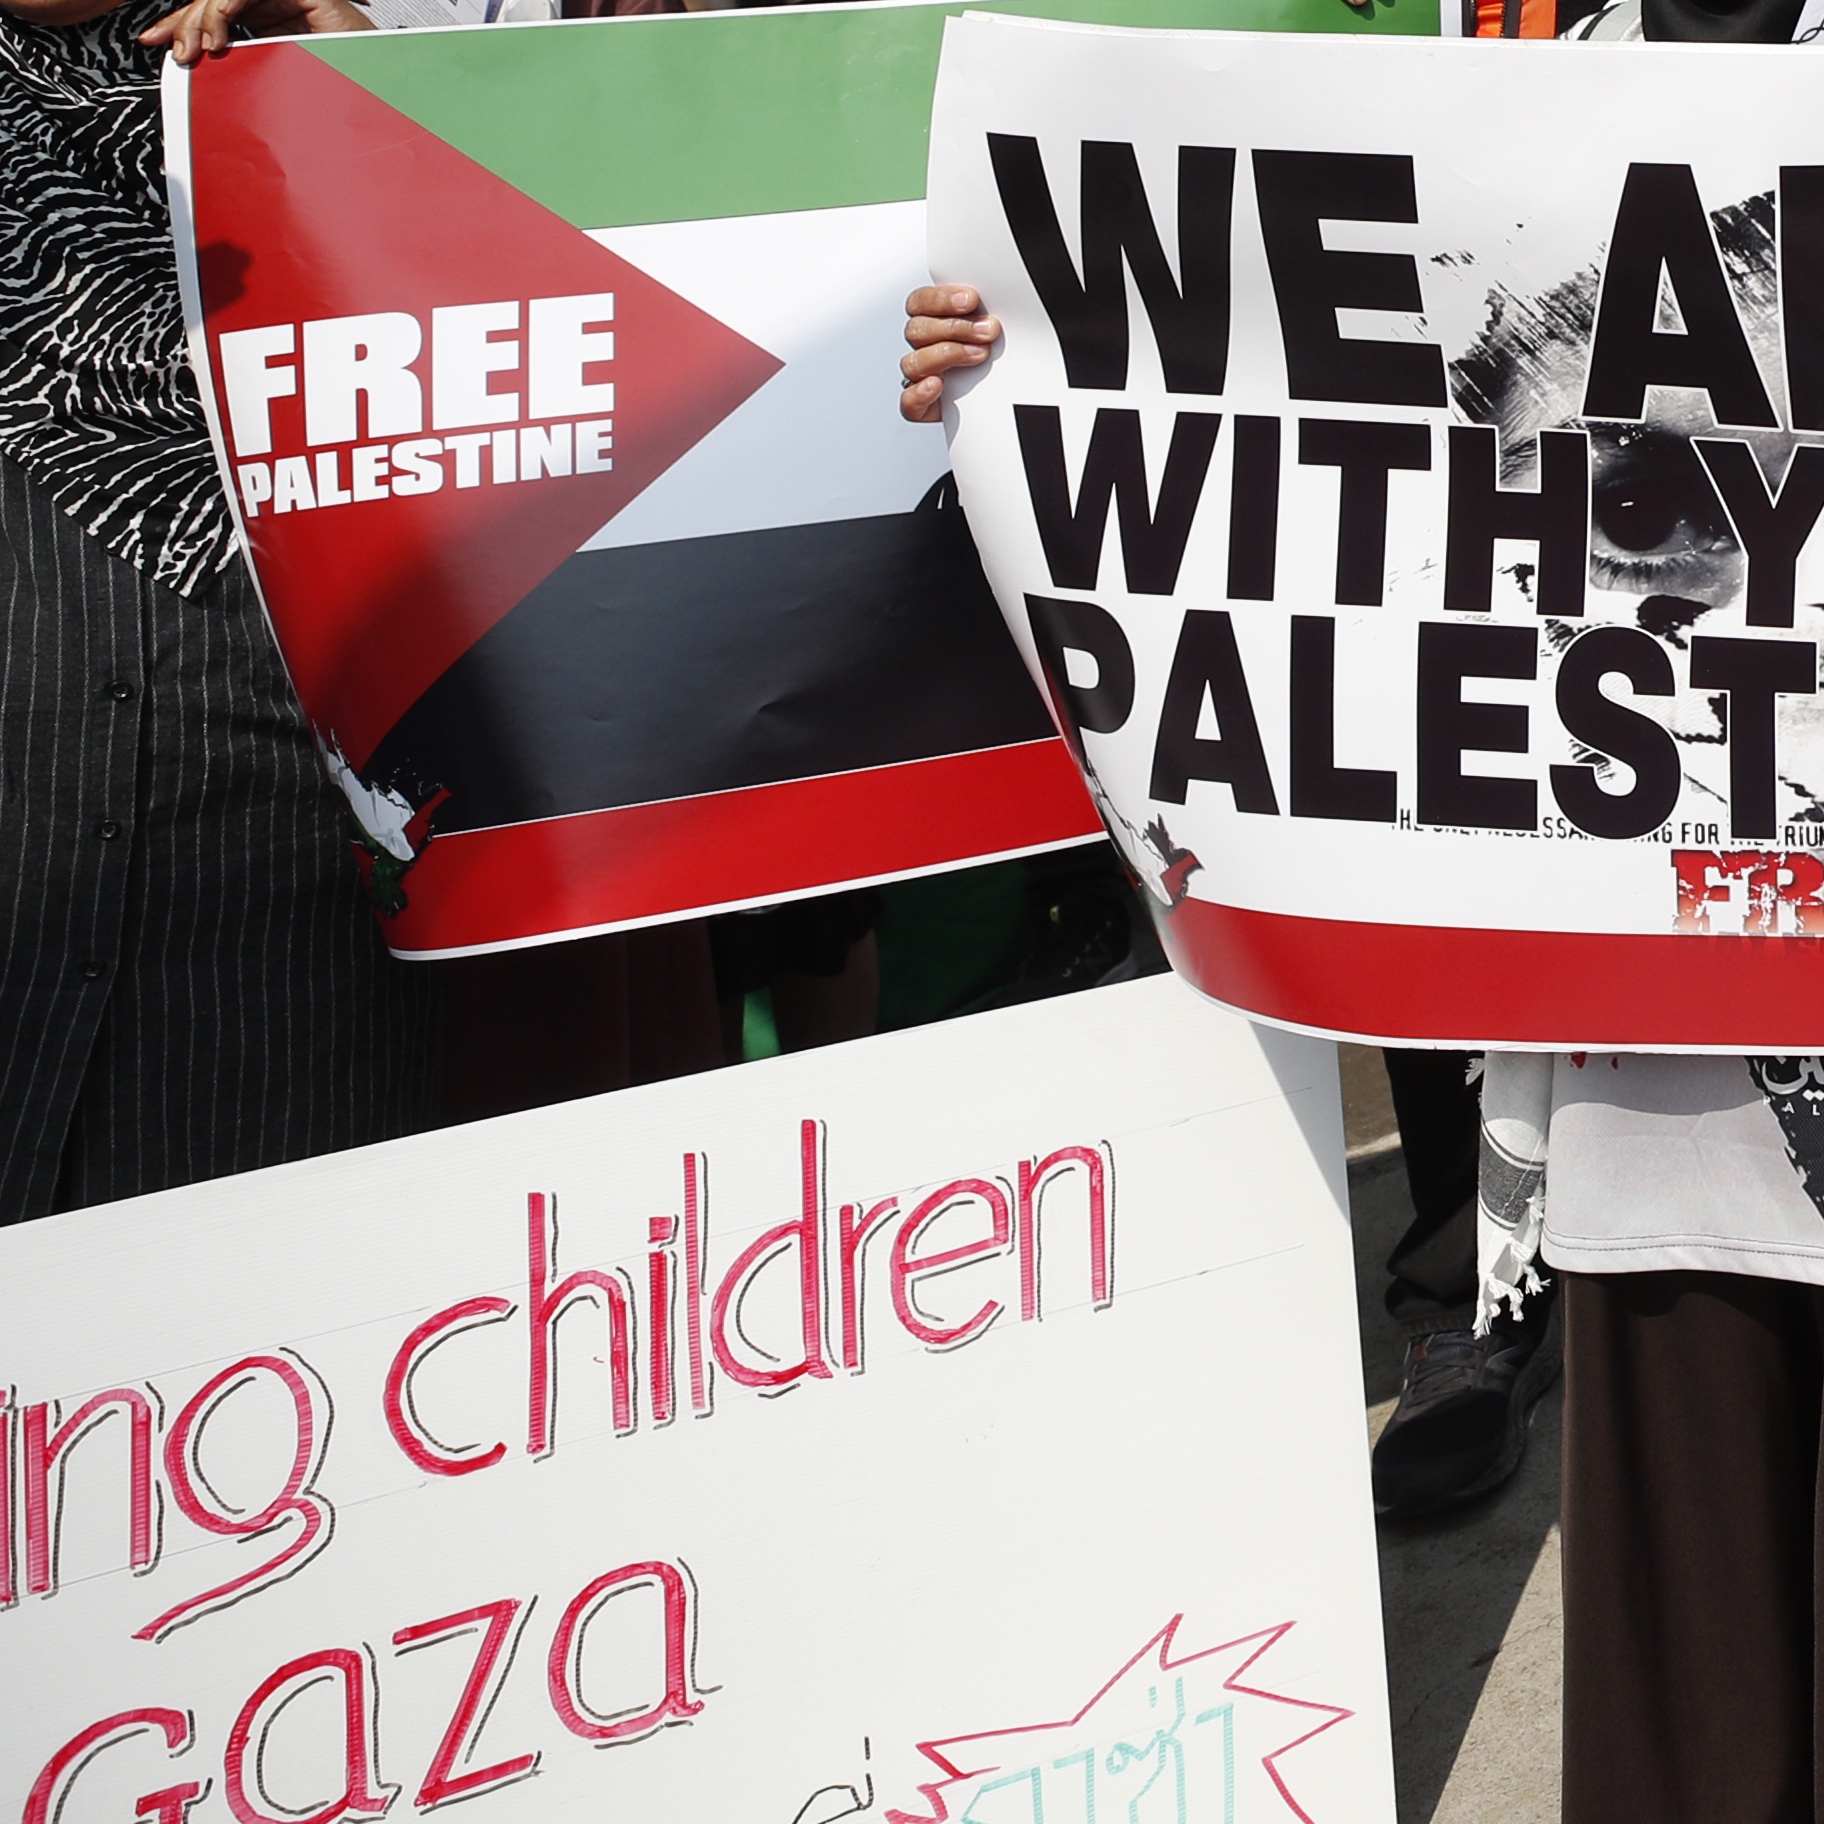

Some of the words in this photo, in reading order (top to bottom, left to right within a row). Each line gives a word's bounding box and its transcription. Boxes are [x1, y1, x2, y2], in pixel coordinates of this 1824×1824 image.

[219, 292, 614, 457] FREE
[986, 132, 1449, 407] WE
[236, 418, 614, 518] PALESTINE
[1013, 403, 1591, 618] WITH
[384, 1119, 1114, 1477] children
[22, 1558, 722, 1824] Gaza
